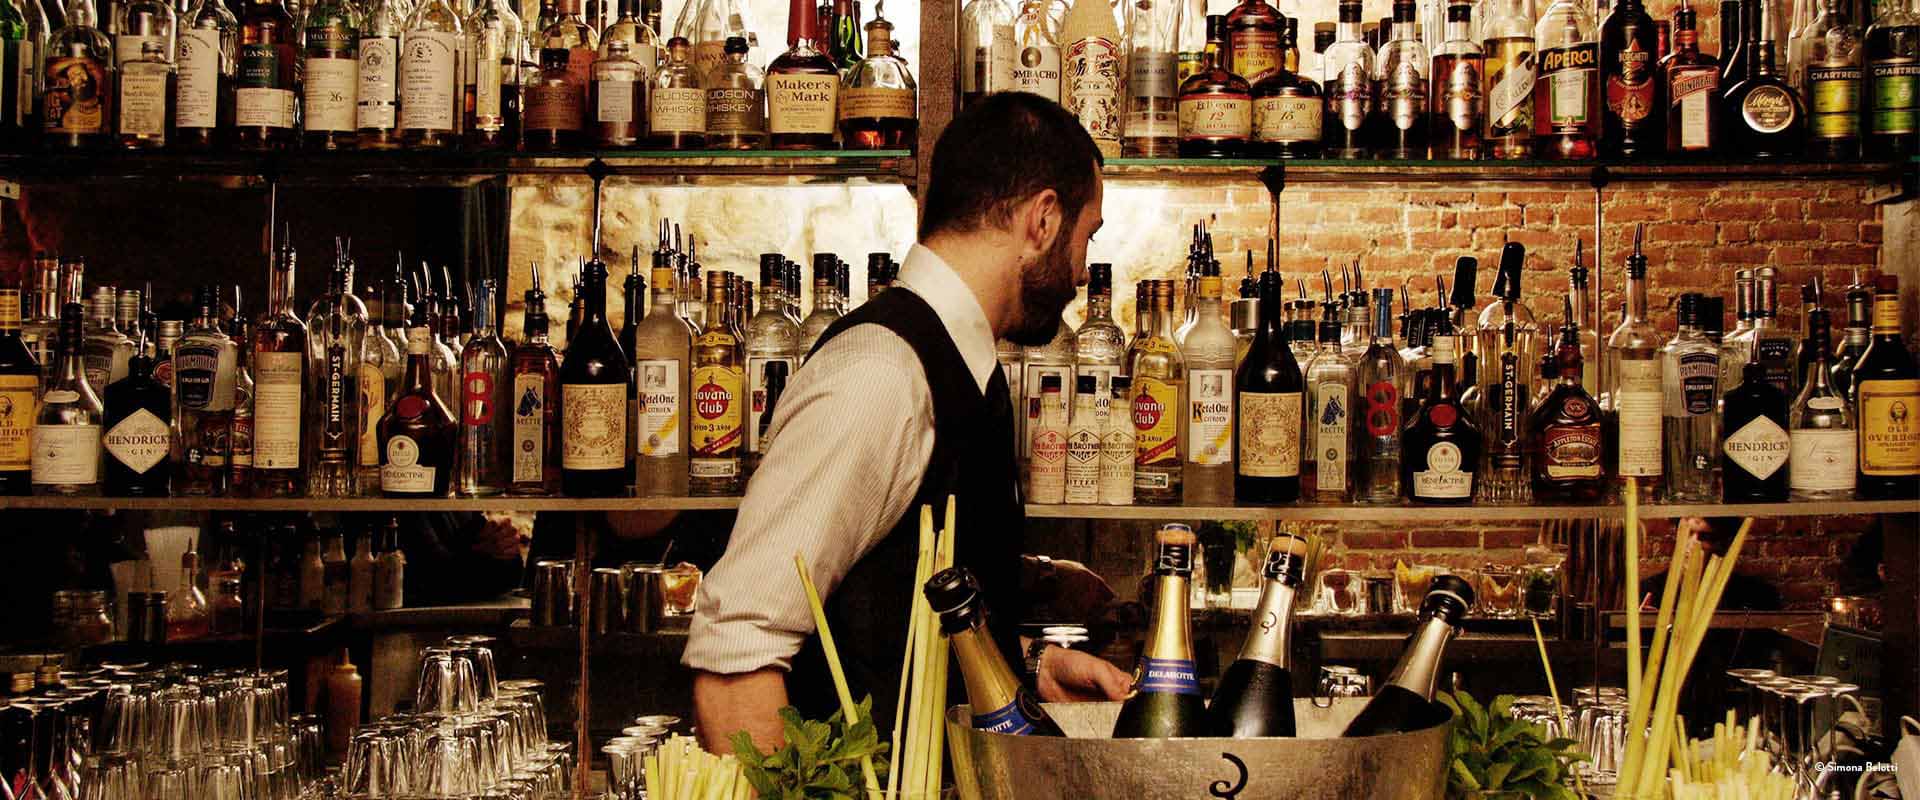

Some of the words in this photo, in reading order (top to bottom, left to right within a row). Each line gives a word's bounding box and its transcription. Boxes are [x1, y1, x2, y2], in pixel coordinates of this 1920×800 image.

[1544, 49, 1594, 71] APEROL
[775, 79, 832, 90] Maker's
[792, 91, 830, 102] Mark
[1209, 112, 1225, 121] 12
[331, 355, 341, 423] ST-GERMAIN
[659, 394, 675, 405] One
[1504, 364, 1514, 430] ST-GERMAIN
[698, 401, 723, 414] Club
[1215, 403, 1229, 413] One
[1366, 380, 1398, 436] 8
[708, 423, 715, 432] 3
[130, 448, 152, 457] GIN
[1752, 454, 1775, 462] GIN
